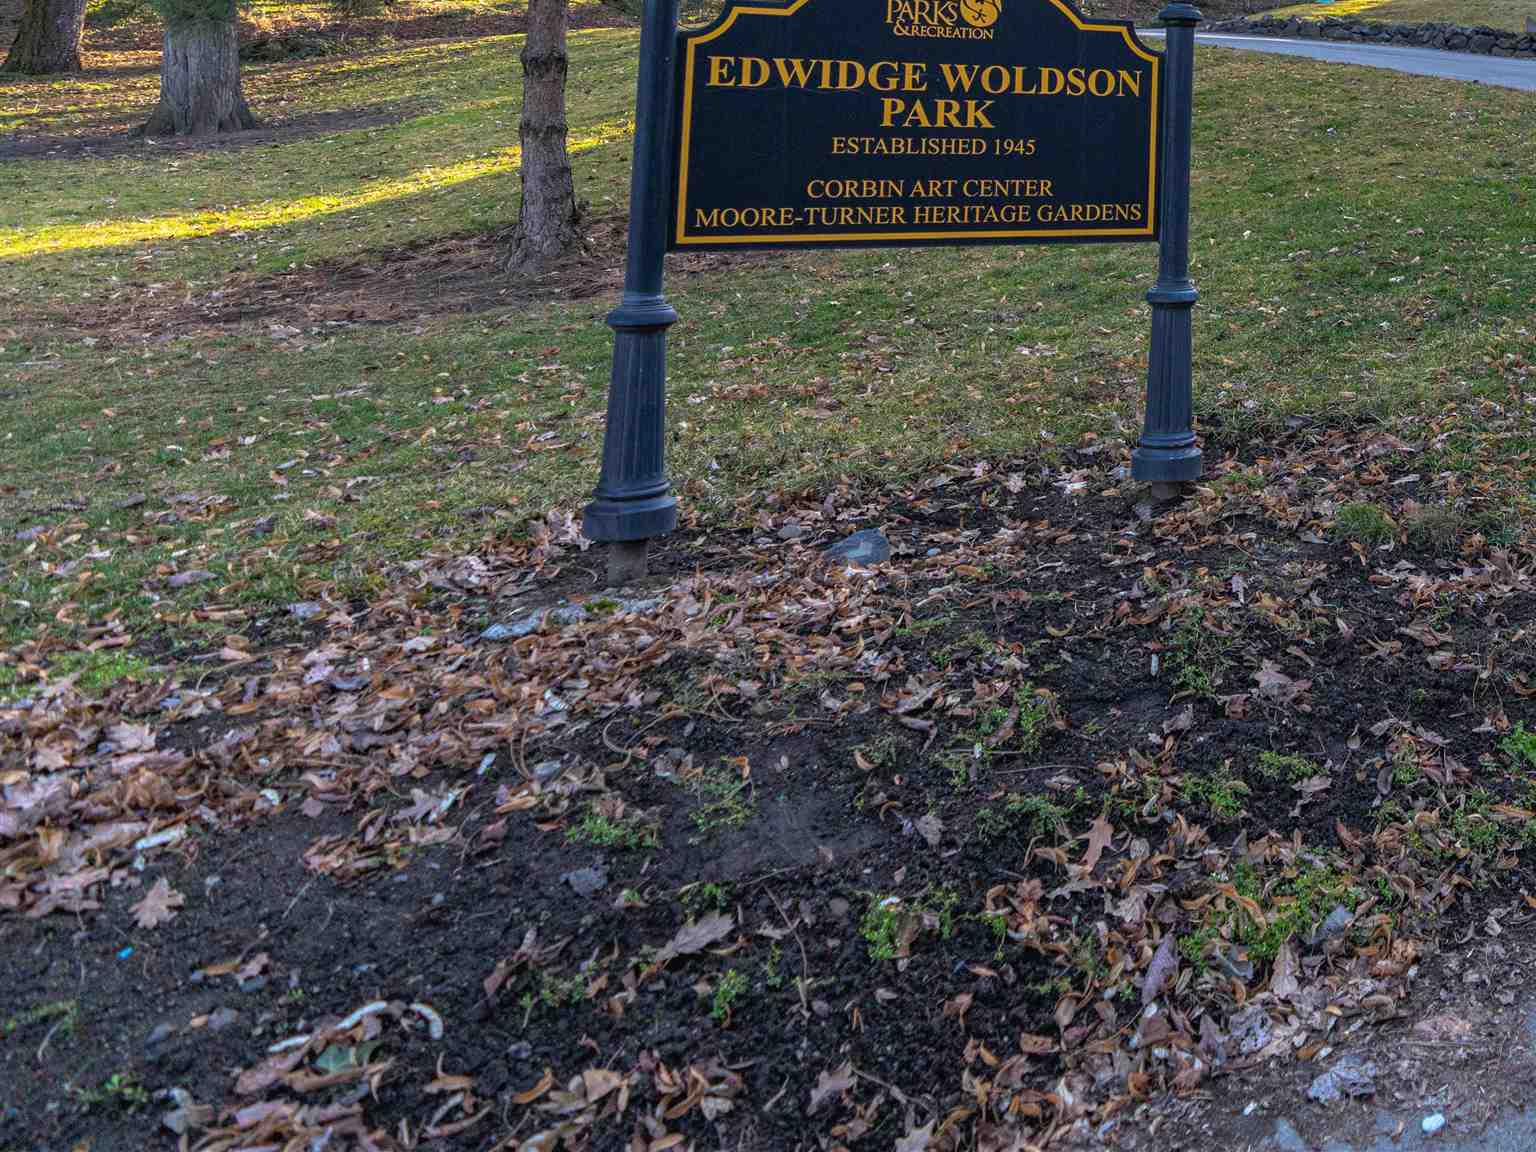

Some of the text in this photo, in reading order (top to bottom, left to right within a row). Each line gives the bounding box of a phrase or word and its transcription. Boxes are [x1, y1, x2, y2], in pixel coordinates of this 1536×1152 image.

[706, 55, 1143, 97] EDWIDGE WOLDSON
[880, 98, 996, 129] PARK
[831, 136, 1036, 156] ESTABLISHED 1945
[807, 179, 1053, 198] CORBIN ART CENTER
[696, 203, 1142, 227] MOORE-TURNER HERITAGE GARDENS
